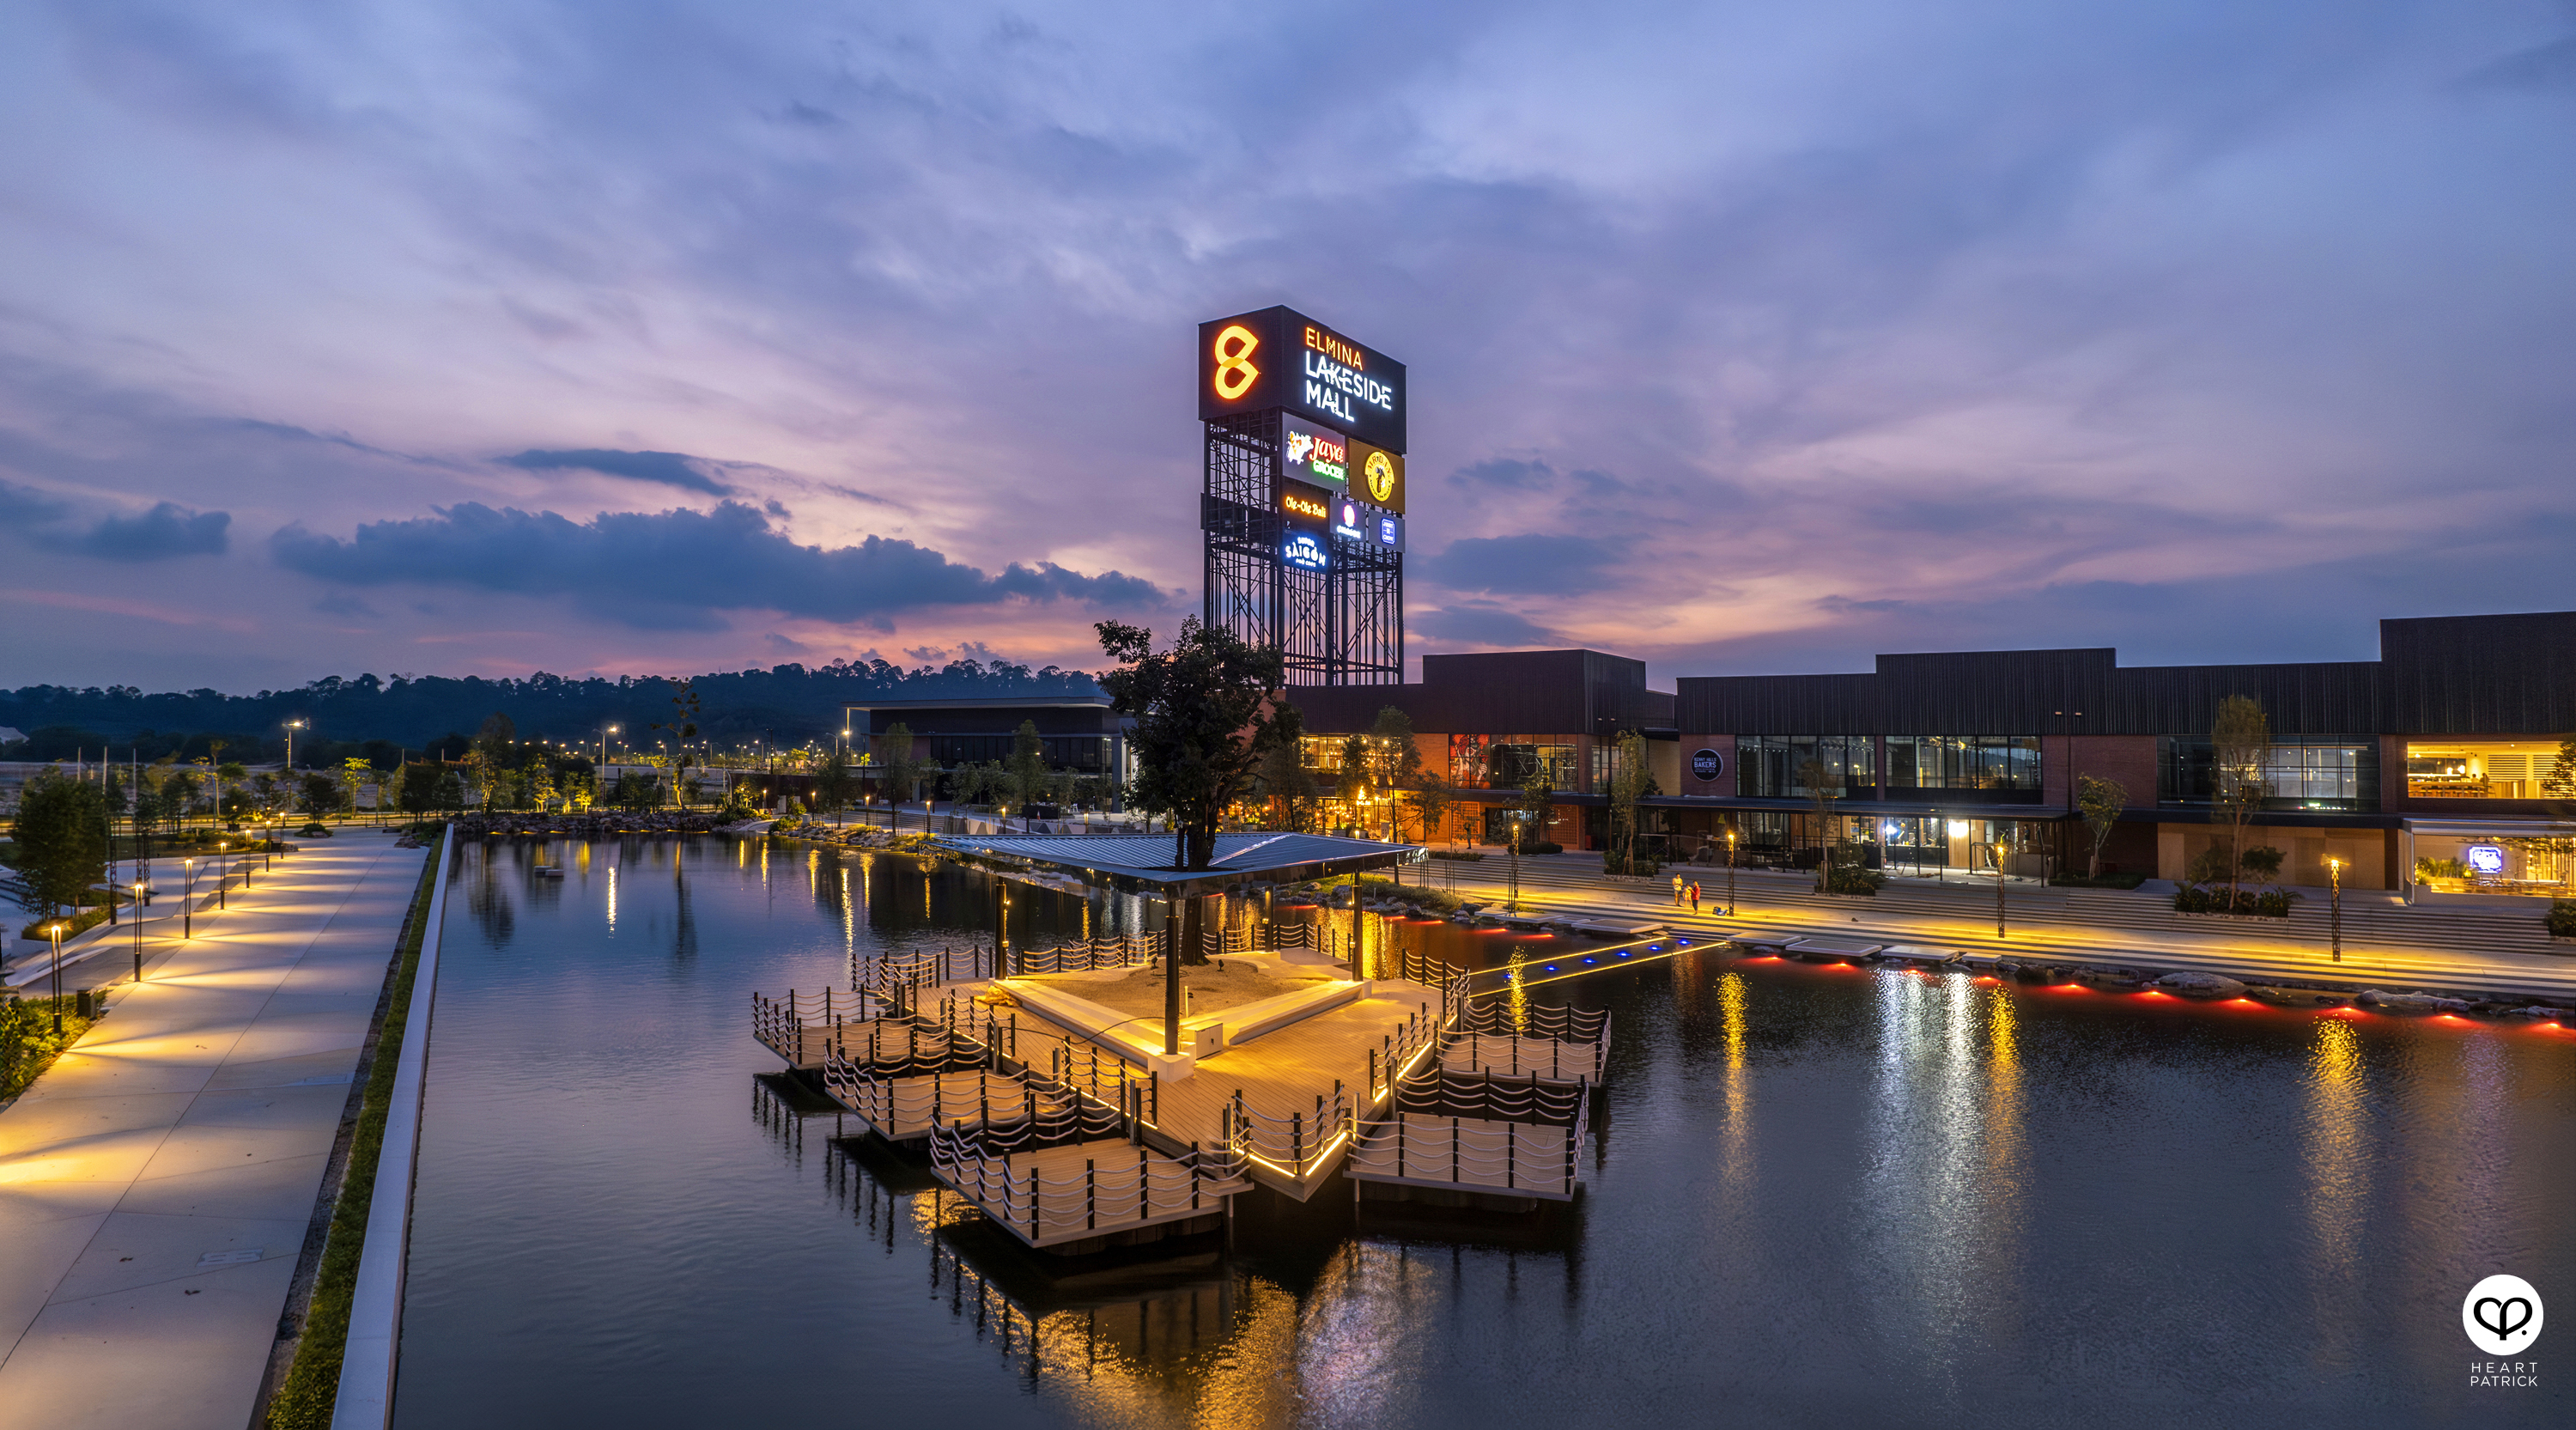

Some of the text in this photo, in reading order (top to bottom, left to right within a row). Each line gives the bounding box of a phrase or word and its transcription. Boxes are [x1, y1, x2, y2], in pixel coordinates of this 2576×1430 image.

[1306, 326, 1363, 370] ELMINA
[1305, 350, 1393, 411] LAKESIDE
[1306, 380, 1355, 422] MALL
[1309, 437, 1344, 463] Jaya
[1312, 503, 1327, 518] Bali
